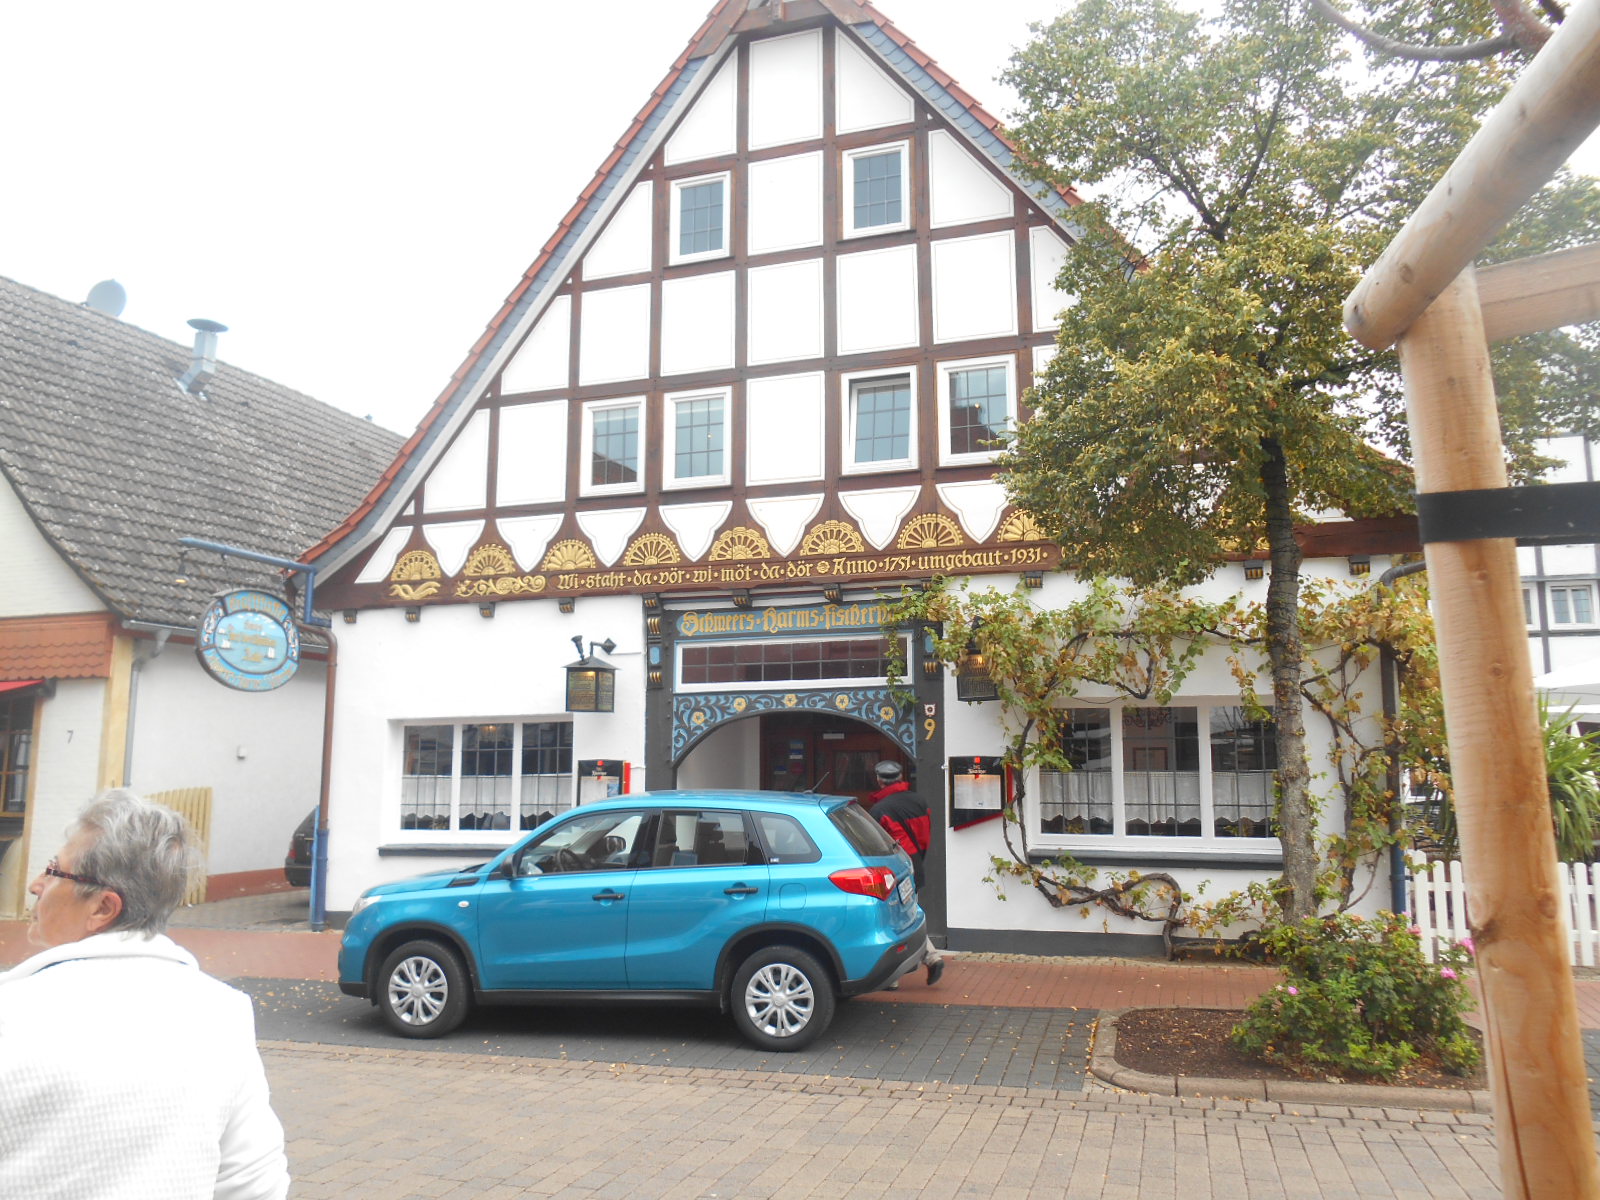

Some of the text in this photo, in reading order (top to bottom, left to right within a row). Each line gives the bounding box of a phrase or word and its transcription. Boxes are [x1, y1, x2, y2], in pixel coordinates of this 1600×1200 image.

[557, 547, 1041, 590] Wi staht da vör wi möt da dör Anno 1751 umgebaut 1931
[763, 606, 819, 634] Harms
[66, 728, 74, 744] 7
[923, 718, 937, 740] 9
